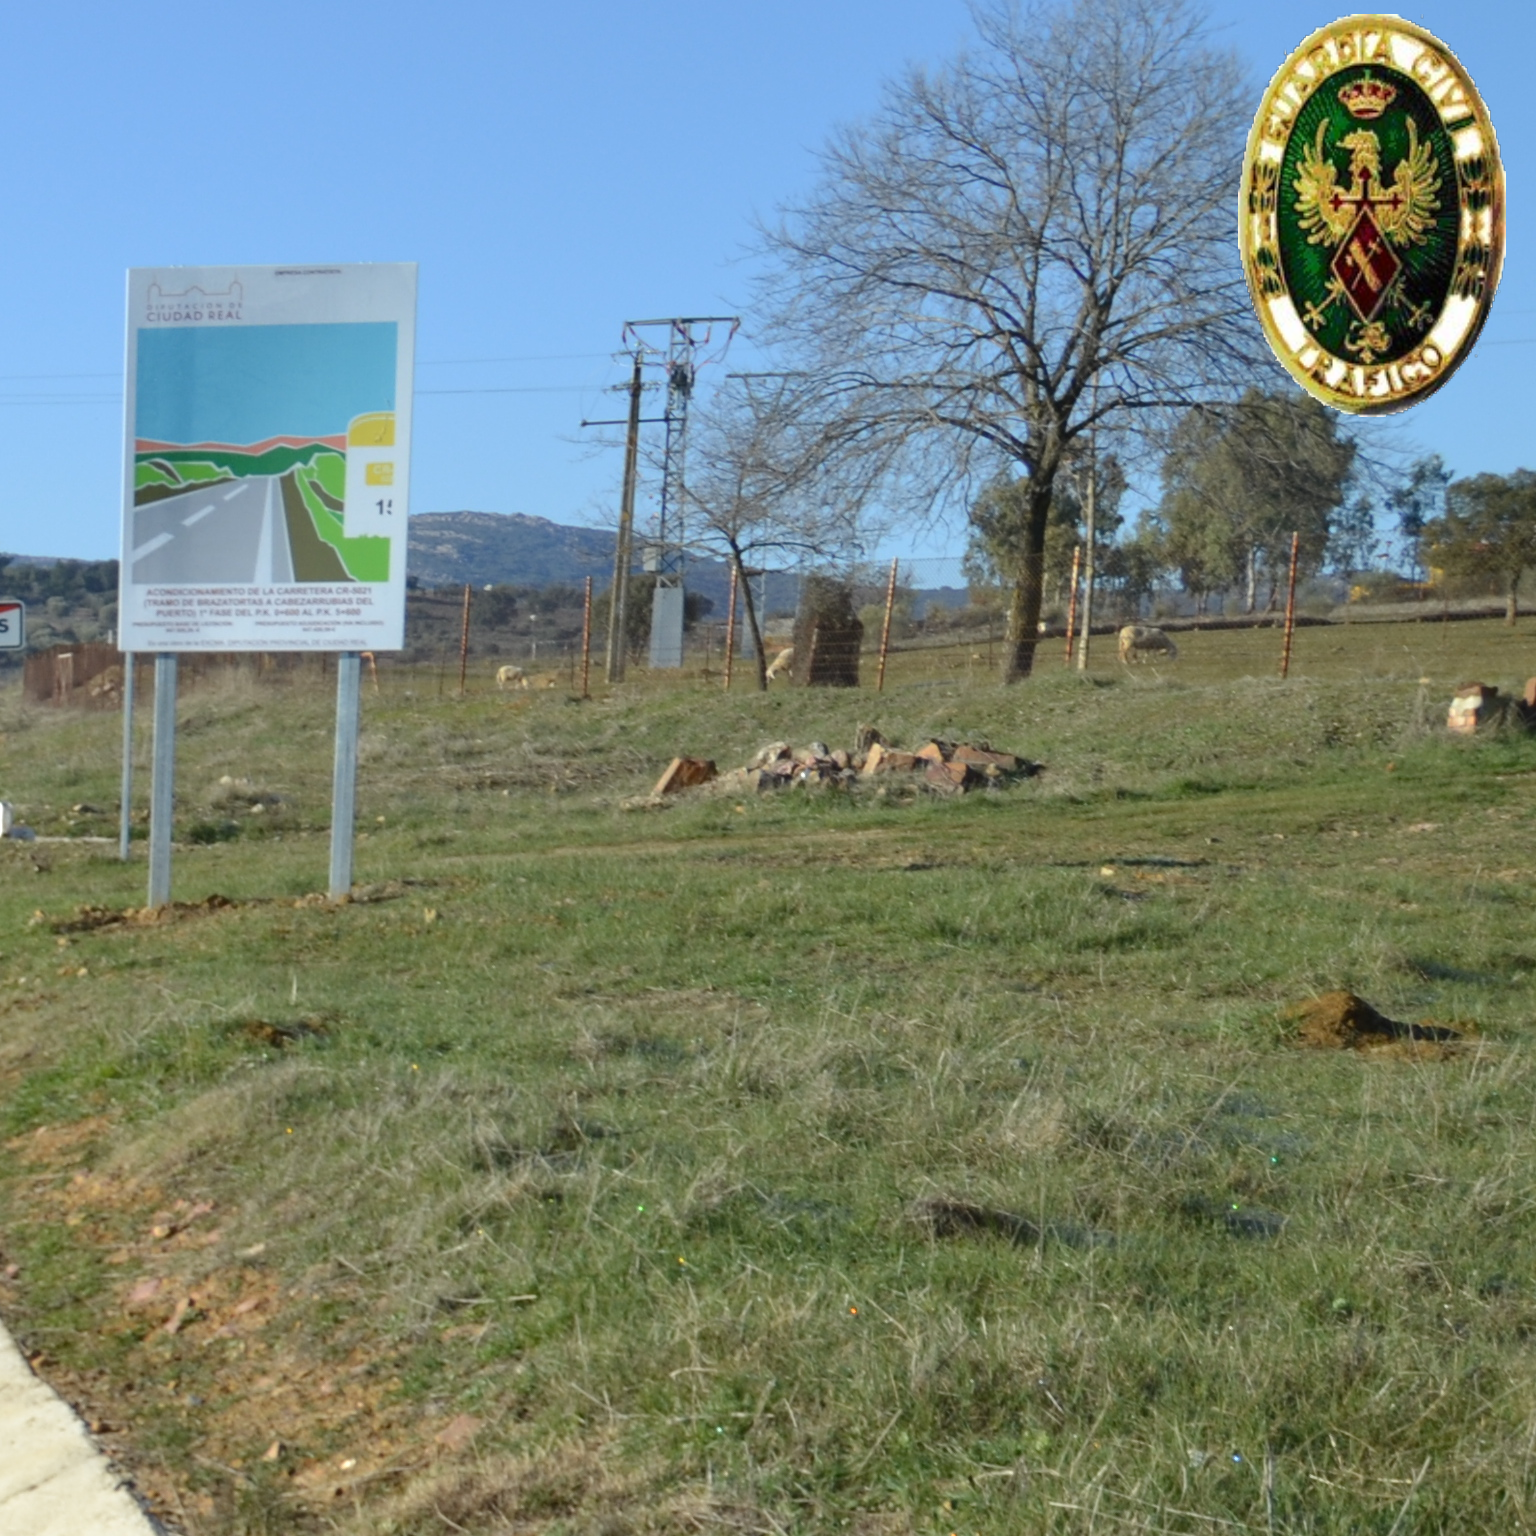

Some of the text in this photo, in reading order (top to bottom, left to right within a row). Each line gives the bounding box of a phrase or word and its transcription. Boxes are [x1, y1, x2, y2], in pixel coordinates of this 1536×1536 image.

[146, 310, 243, 322] CIUDAD REAL
[146, 588, 245, 596] ACONDICIONAMIENTO
[262, 587, 274, 595] LA
[277, 587, 333, 595] CARRETERA
[144, 598, 180, 607] (TRAMO
[182, 598, 194, 606] DE
[197, 598, 263, 606] BRAZATORTAS
[274, 597, 353, 605] CABEZARRUBIAS
[356, 597, 373, 605] DEL
[156, 609, 196, 617] PUERTO)
[302, 608, 312, 616] AL
